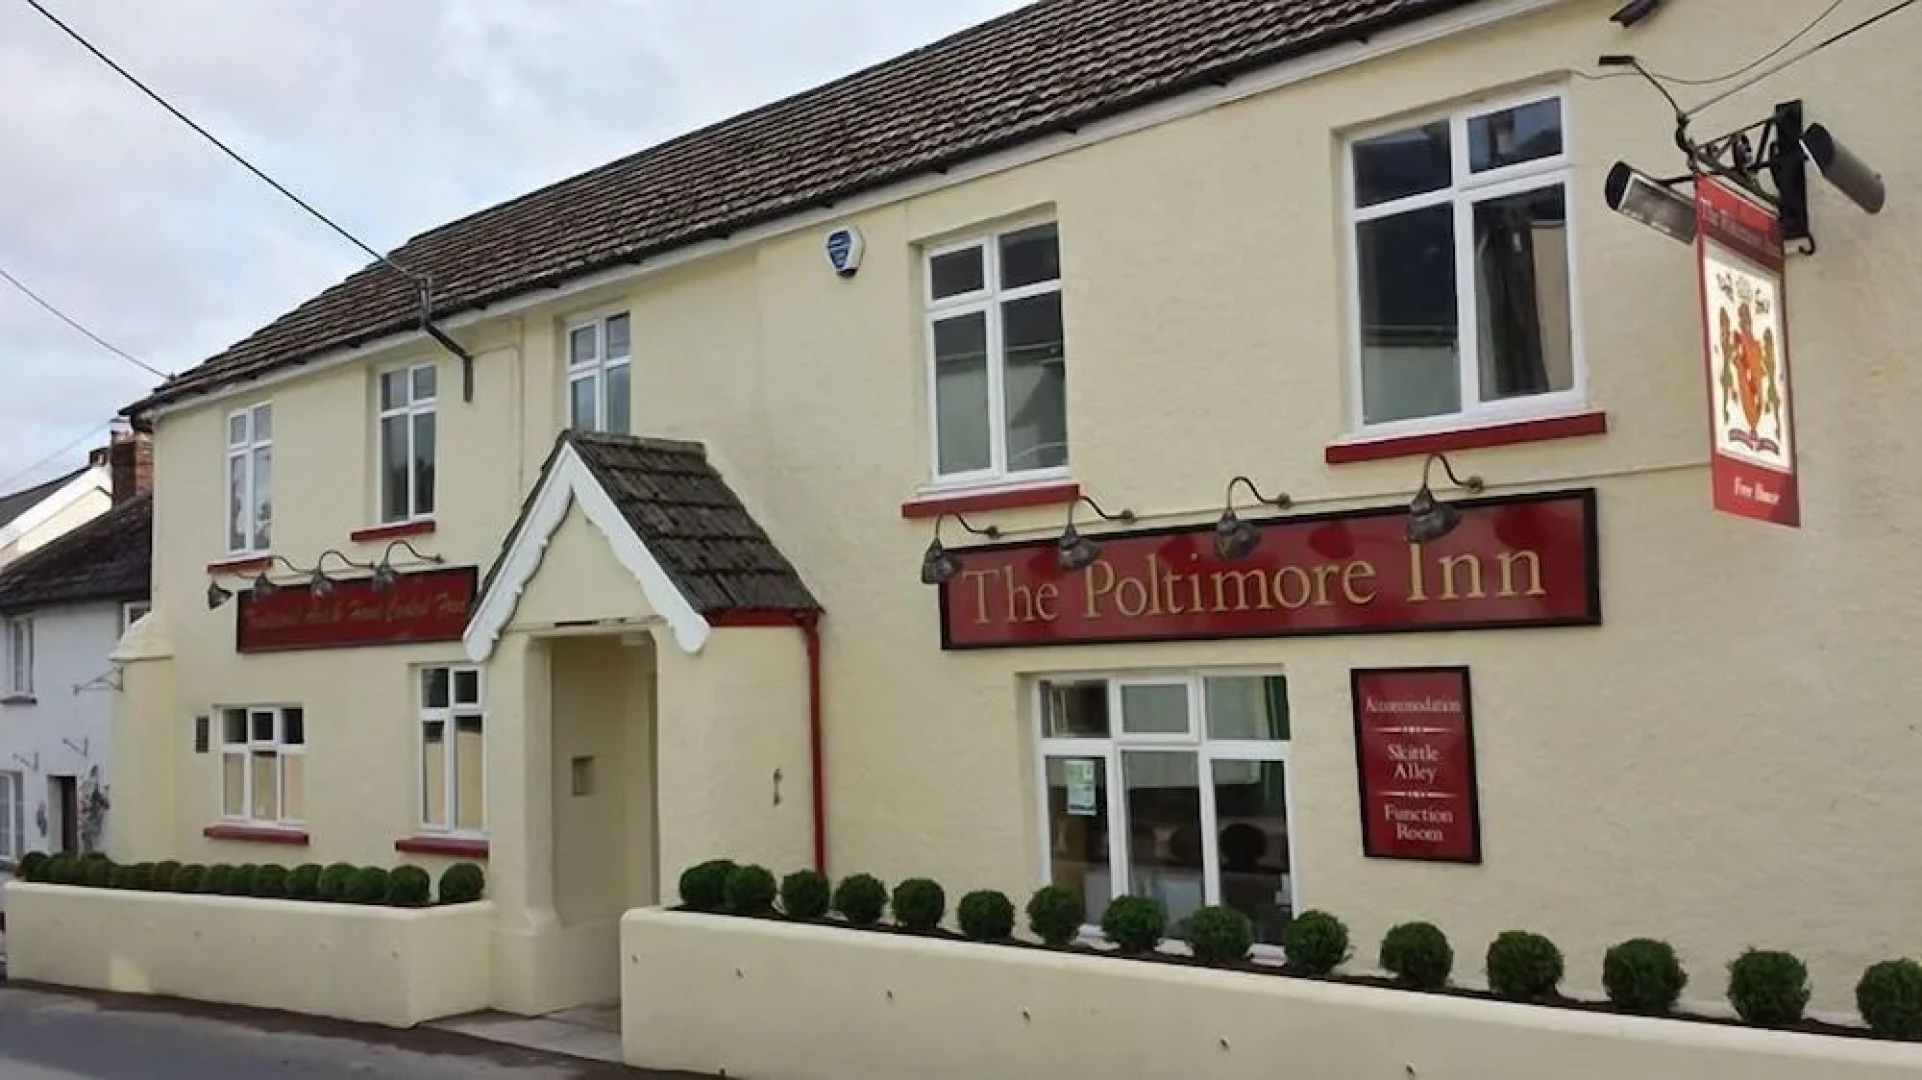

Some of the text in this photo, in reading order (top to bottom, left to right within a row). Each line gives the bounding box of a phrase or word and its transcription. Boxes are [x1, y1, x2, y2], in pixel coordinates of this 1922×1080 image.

[963, 537, 1547, 625] The Poltimore Inn
[1386, 743, 1440, 762] Skittle
[1393, 763, 1437, 784] Alley
[1384, 804, 1454, 823] Function
[1396, 822, 1445, 842] Room
